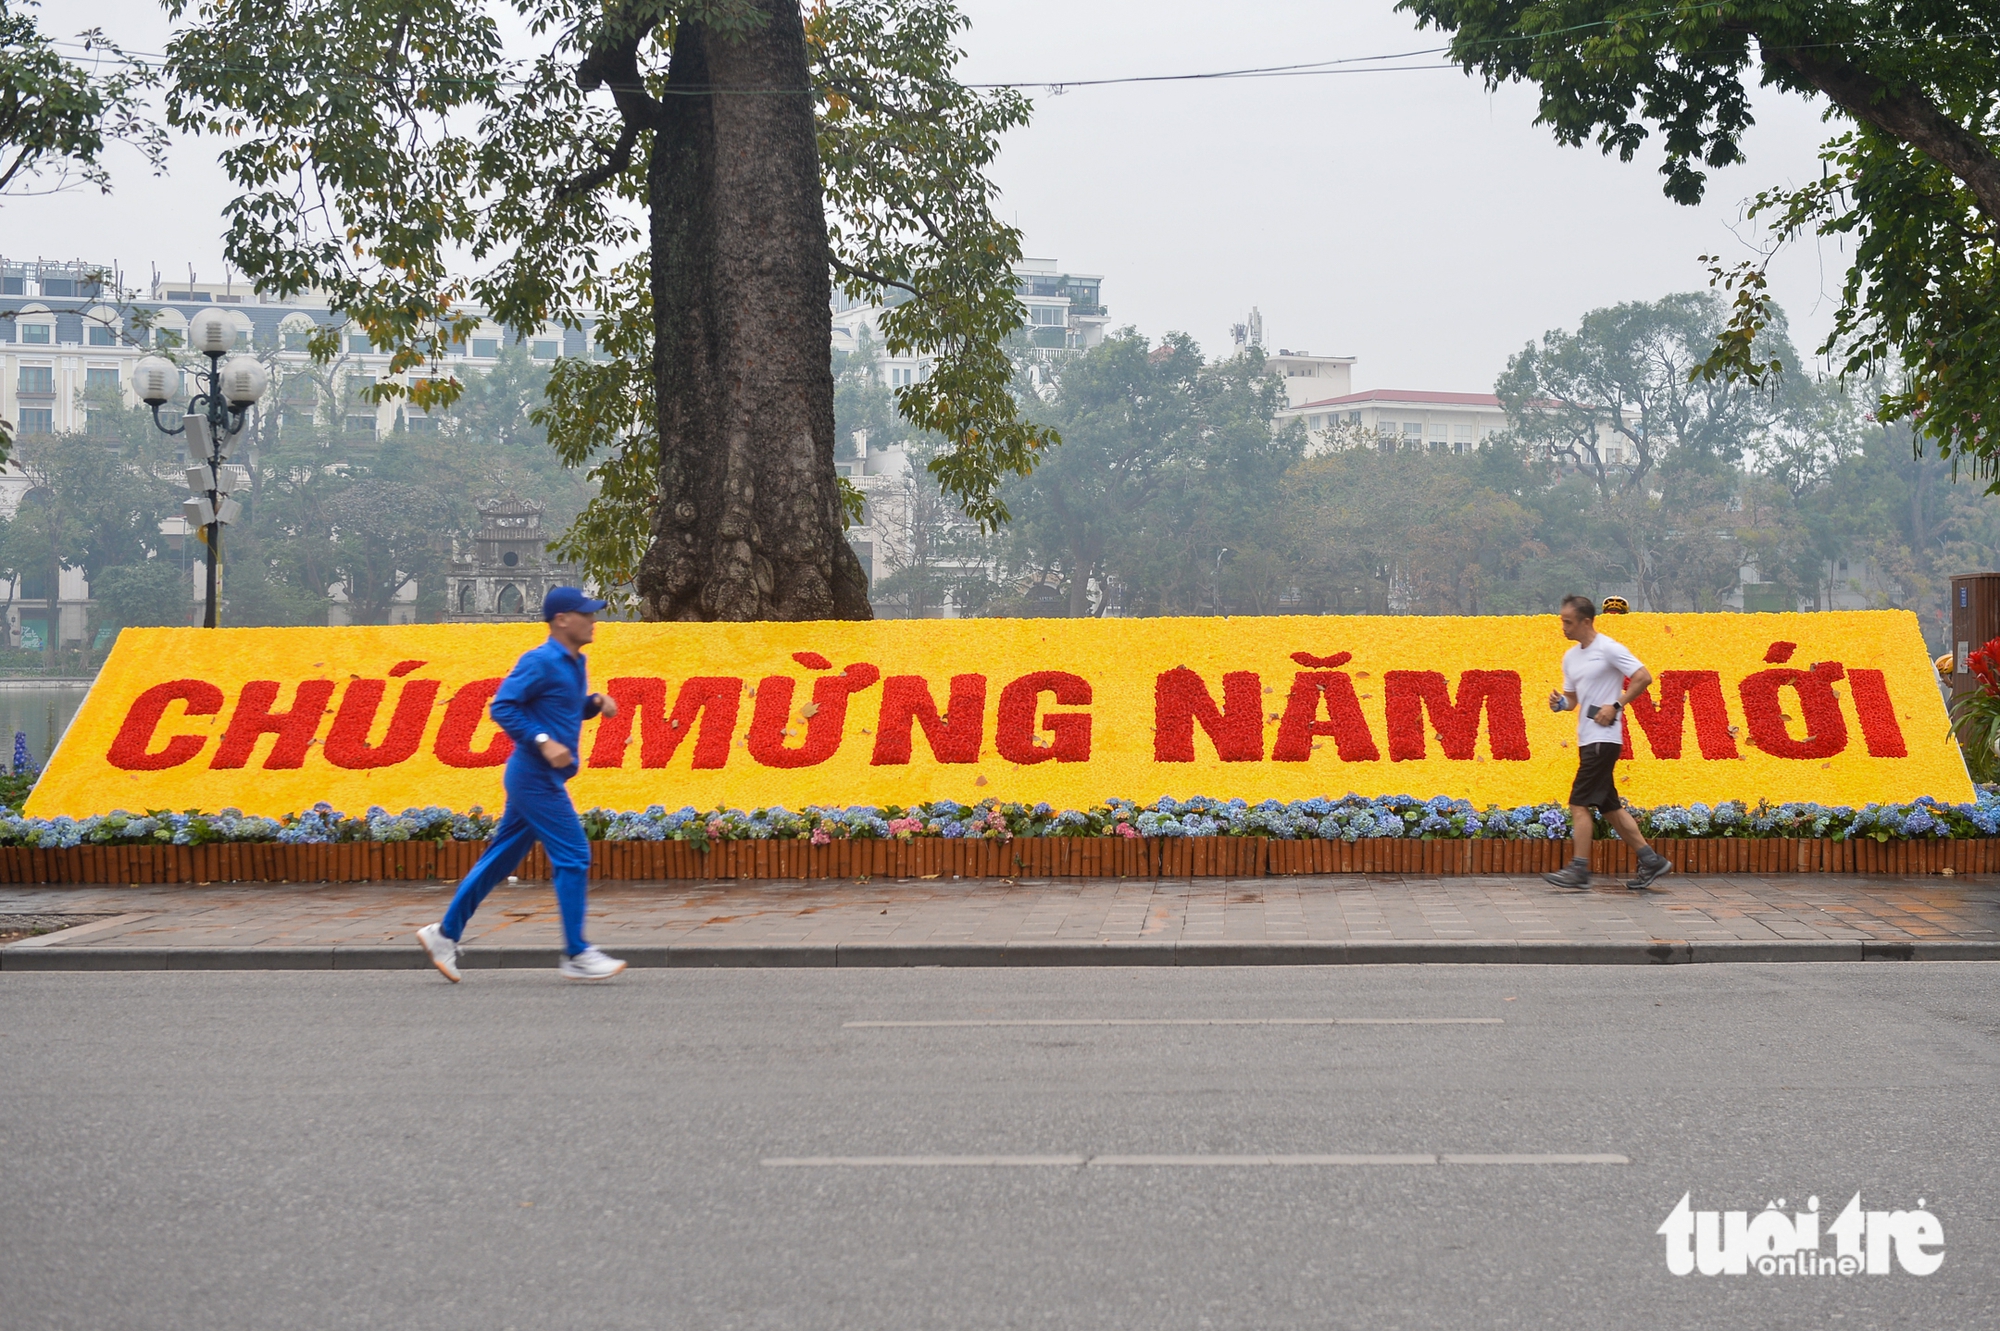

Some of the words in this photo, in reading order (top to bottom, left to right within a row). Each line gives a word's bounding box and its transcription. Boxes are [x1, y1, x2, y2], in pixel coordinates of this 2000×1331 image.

[107, 660, 514, 771] CHÚC
[588, 651, 1093, 770] MỪNG
[1154, 651, 1531, 763] NĂM
[1619, 641, 1908, 760] MỚI
